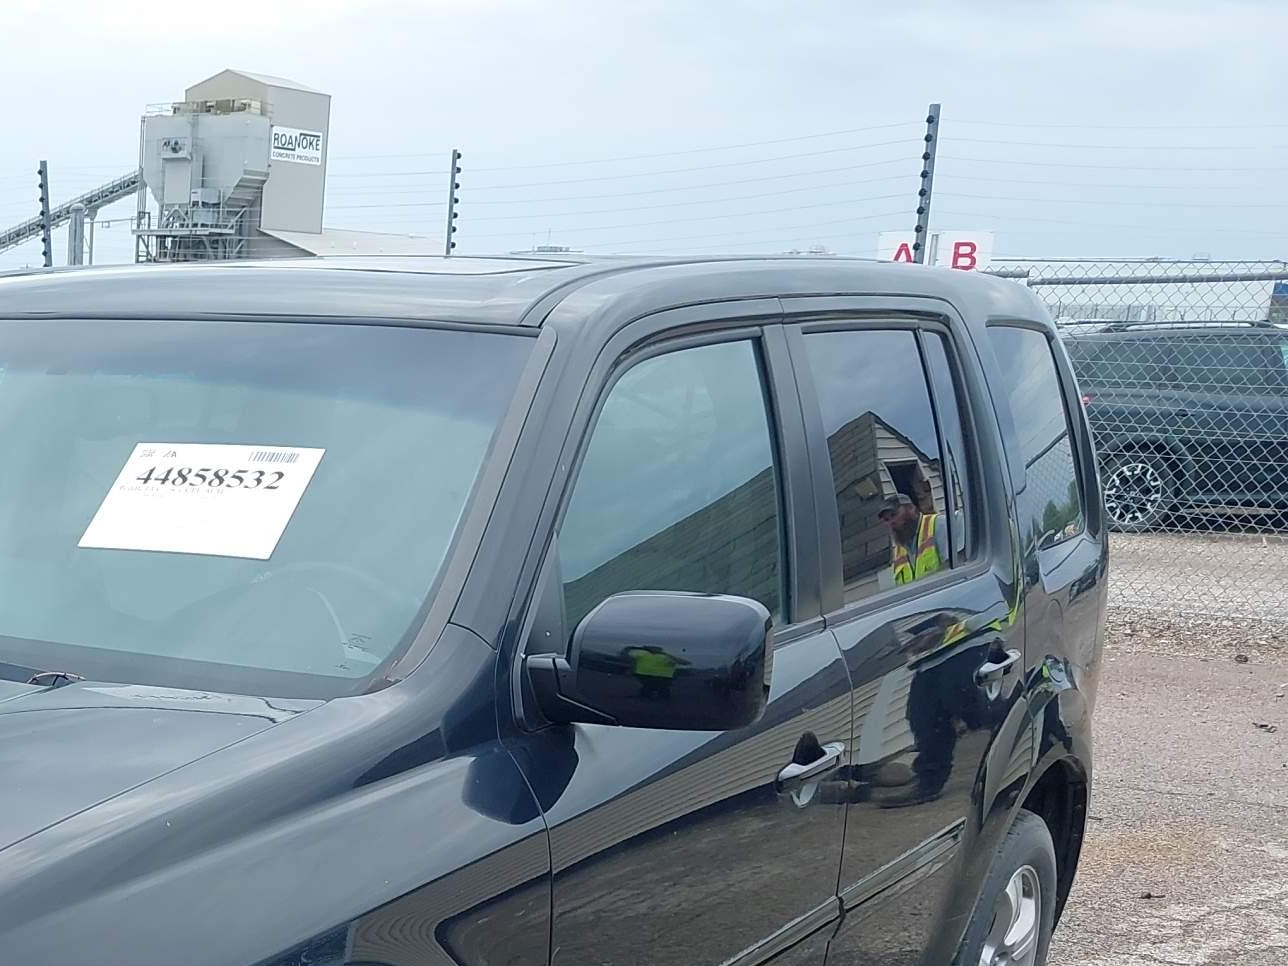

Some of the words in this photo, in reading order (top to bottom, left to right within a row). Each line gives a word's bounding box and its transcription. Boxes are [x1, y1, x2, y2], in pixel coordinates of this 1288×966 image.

[273, 132, 321, 152] ROANOKE
[272, 152, 295, 161] CONCRETE
[296, 155, 320, 163] PRODUCTS
[951, 241, 977, 271] B
[136, 465, 285, 490] 44858532
